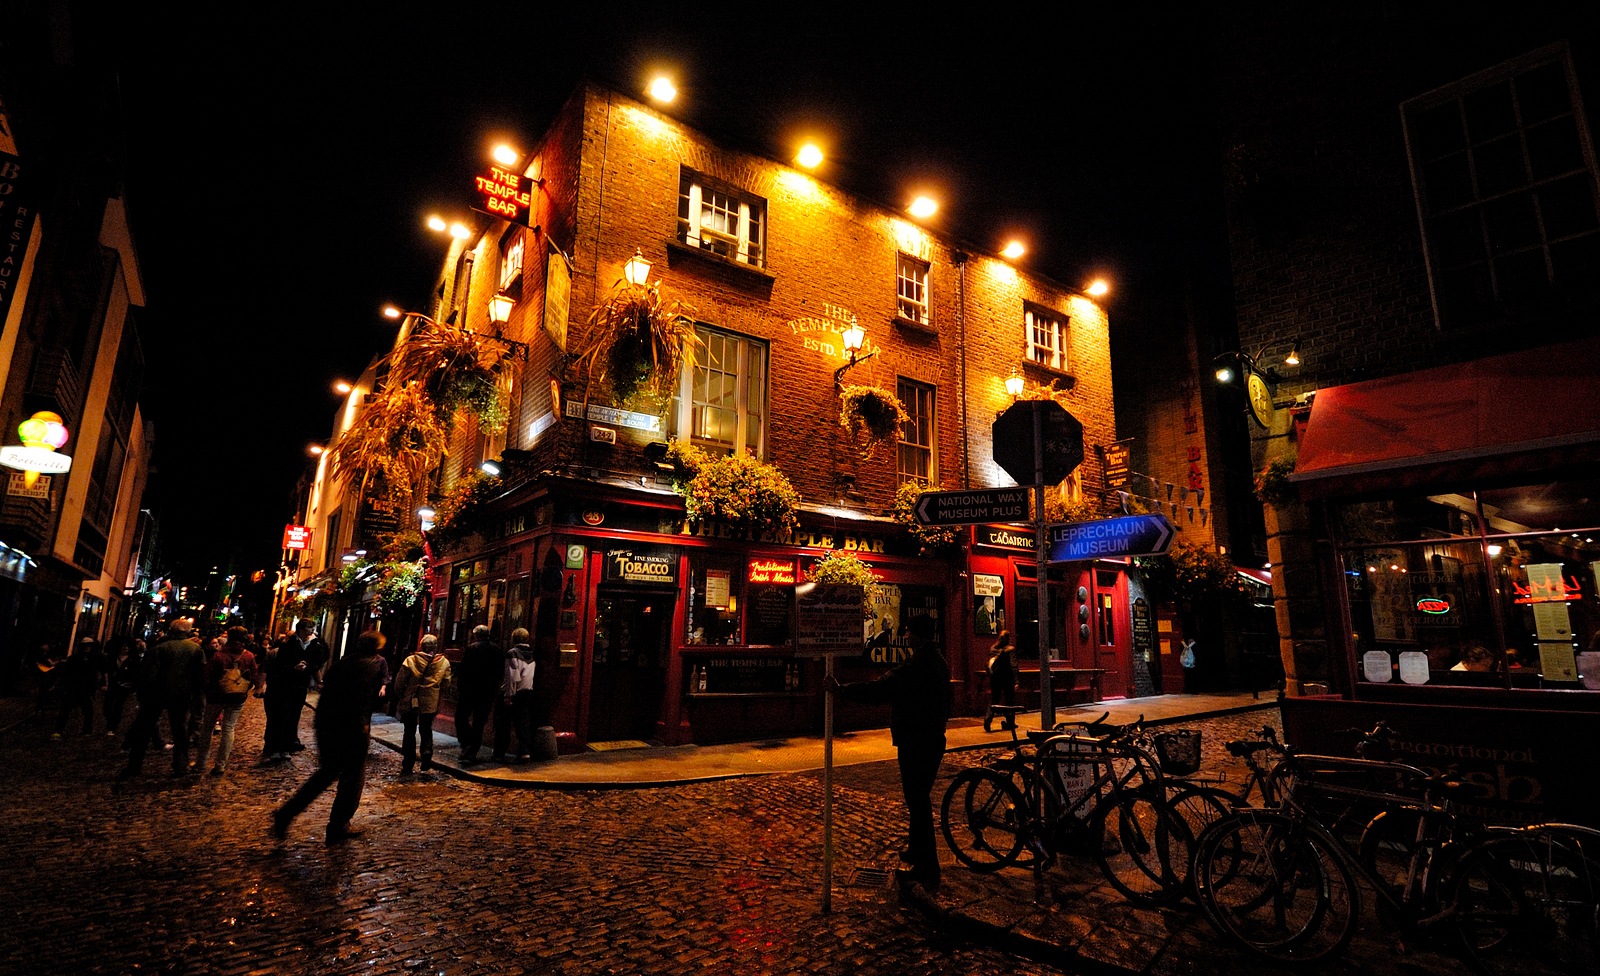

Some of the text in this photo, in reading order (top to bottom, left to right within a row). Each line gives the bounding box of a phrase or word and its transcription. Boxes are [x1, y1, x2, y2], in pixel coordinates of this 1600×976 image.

[490, 167, 519, 187] THE
[475, 177, 531, 206] TEMPLE
[488, 196, 517, 216] BAR
[822, 303, 852, 323] THE
[804, 337, 837, 356] ESTD.
[587, 412, 608, 421] TEMPLE
[626, 419, 647, 428] SOUTH
[1187, 446, 1204, 492] BAR
[938, 492, 1024, 507] NATIONAL WAX
[938, 505, 1022, 520] MUSEUM PLUS
[505, 515, 525, 537] BAR
[682, 518, 886, 553] THE TEMPLE BAR
[1053, 521, 1146, 542] LEPRECHAUN
[1069, 538, 1129, 555] MUSEUM
[615, 556, 669, 578] TOBACCO
[751, 561, 793, 572] Traditional
[750, 572, 795, 583] Irish Music
[798, 587, 862, 606] Shan
[875, 596, 891, 605] BAR
